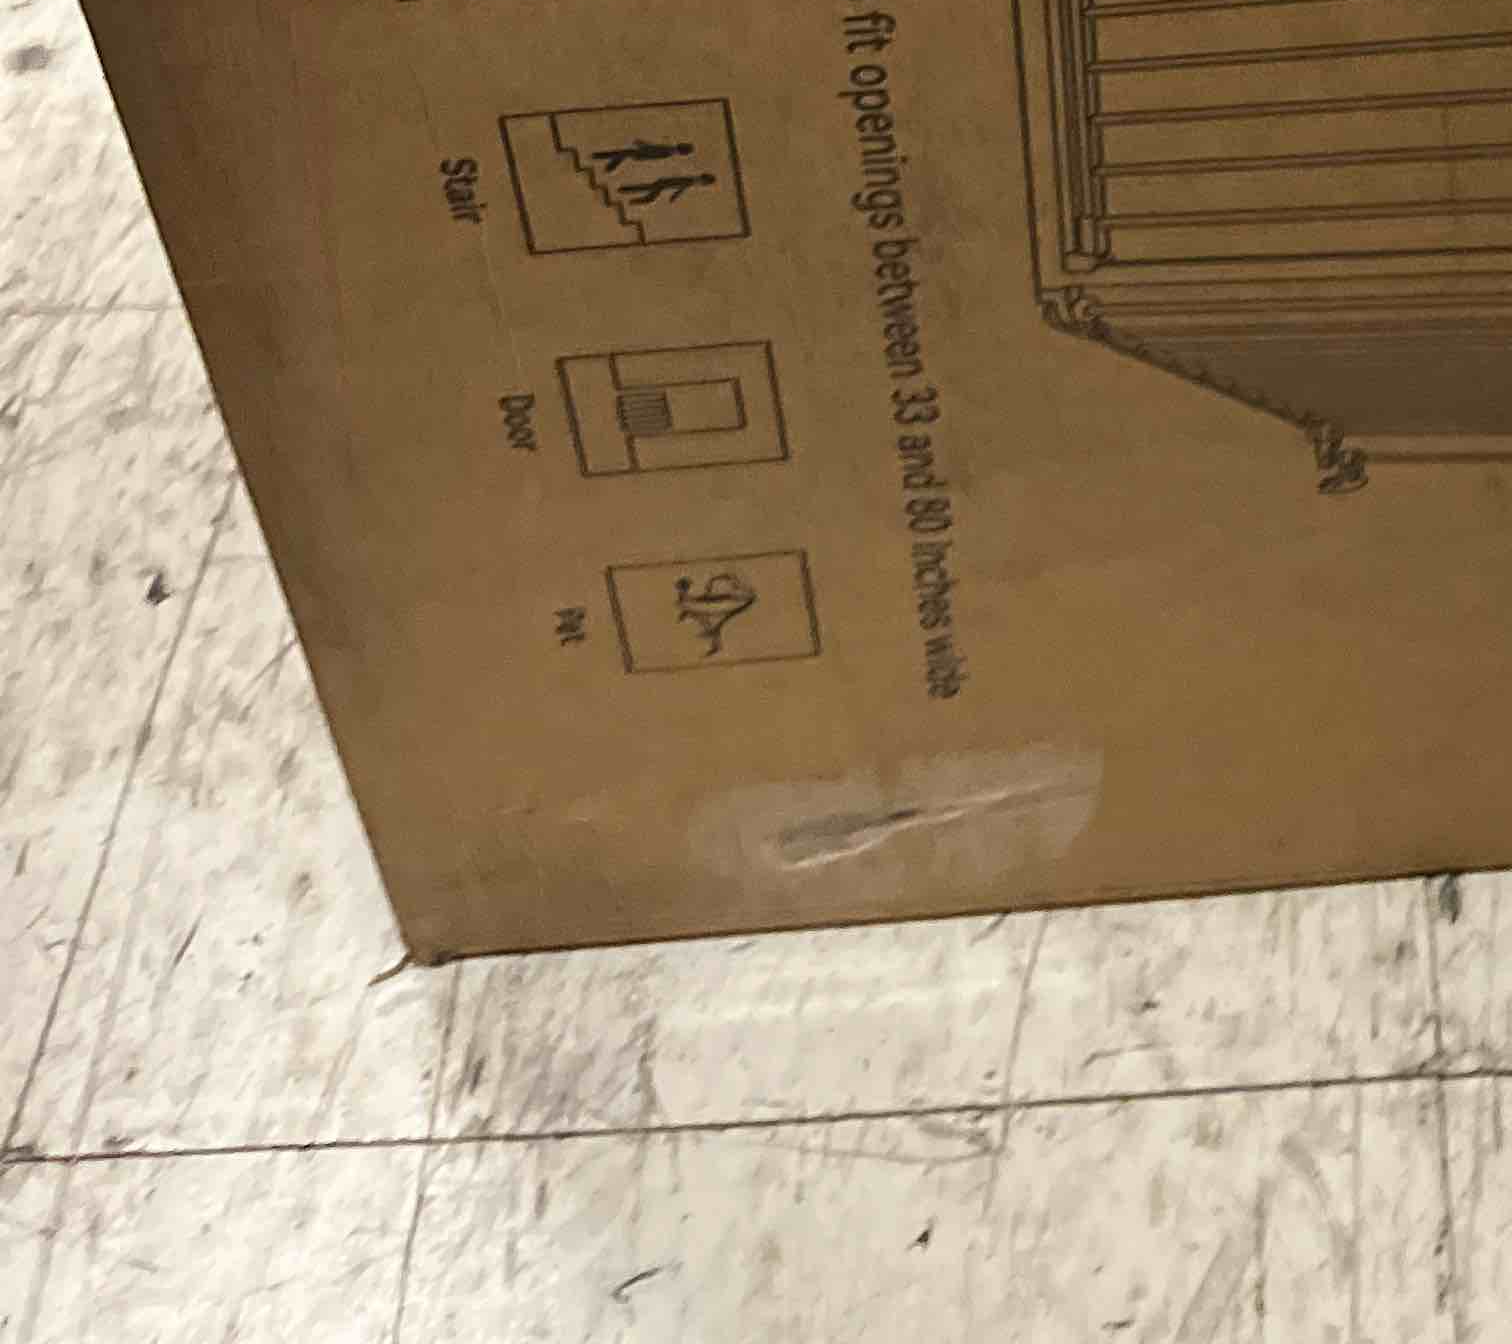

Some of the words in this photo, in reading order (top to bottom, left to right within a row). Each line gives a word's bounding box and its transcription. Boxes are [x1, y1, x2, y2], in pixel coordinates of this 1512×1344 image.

[842, 11, 896, 54] fit
[837, 64, 908, 229] openings
[440, 158, 488, 224] Stair
[872, 238, 923, 379] between
[498, 393, 536, 452] Door
[890, 386, 940, 425] 33
[897, 433, 950, 490] and
[906, 497, 952, 534] 80
[911, 539, 958, 630] inches
